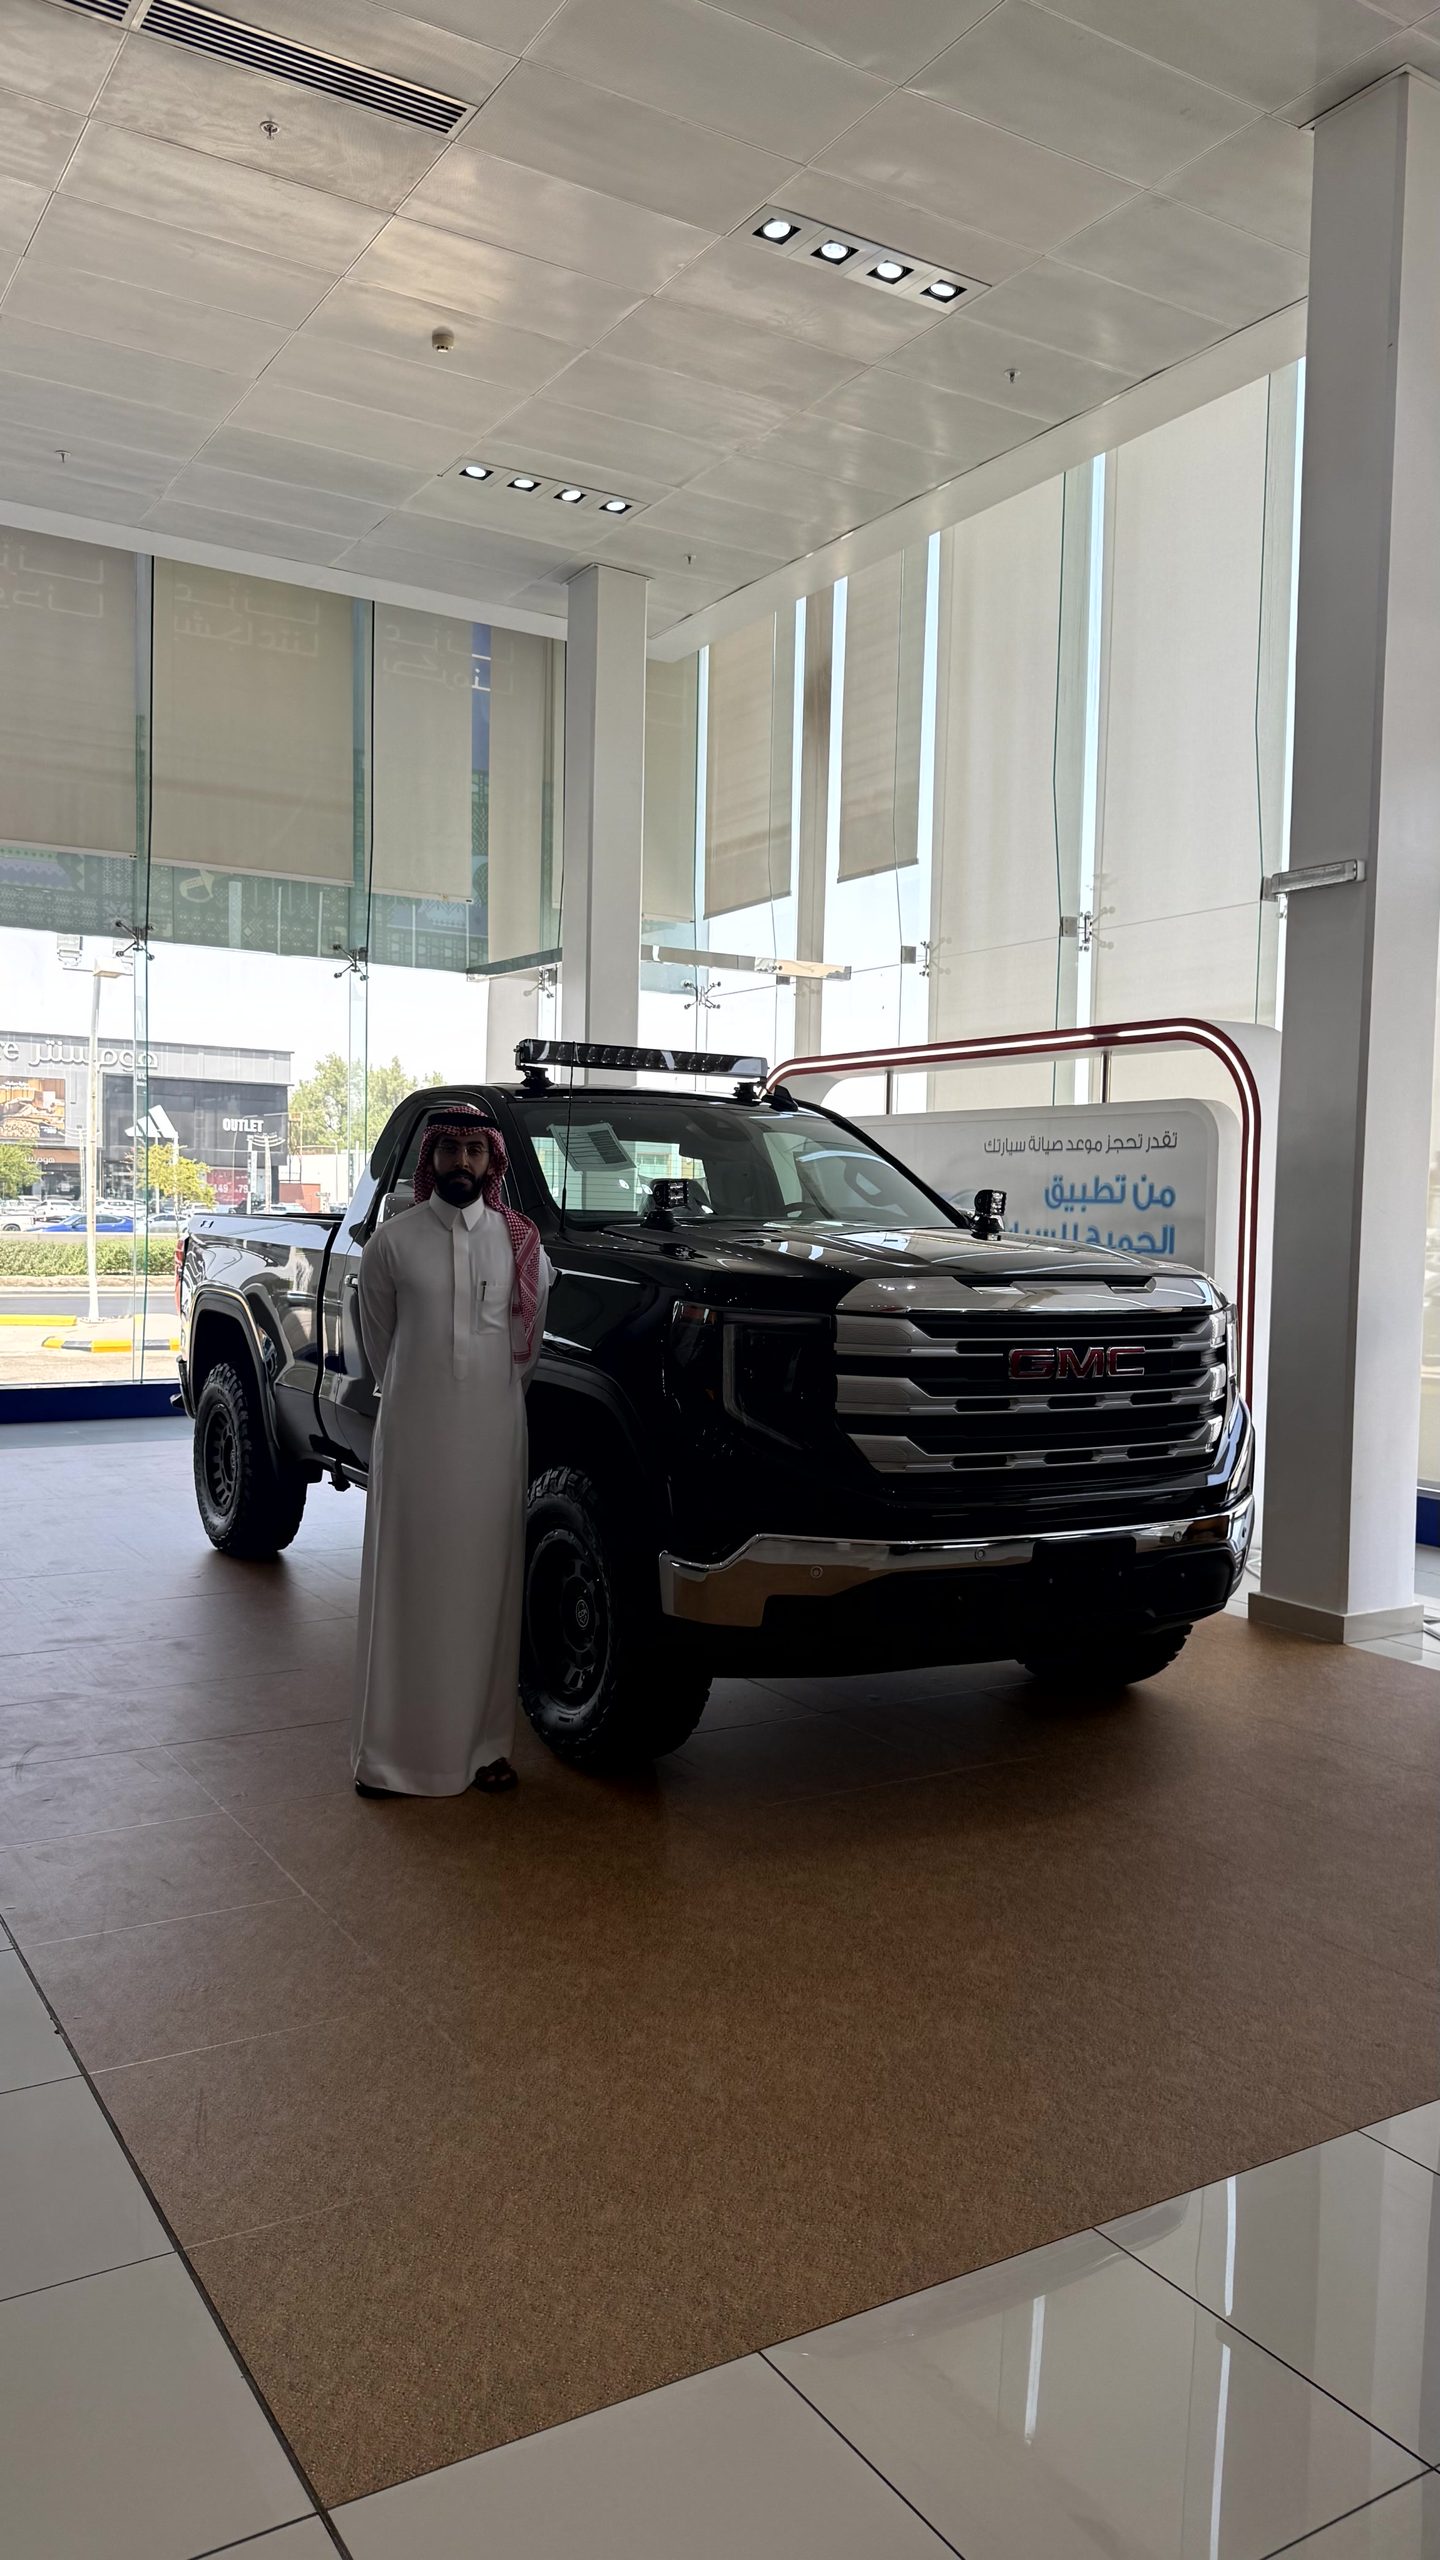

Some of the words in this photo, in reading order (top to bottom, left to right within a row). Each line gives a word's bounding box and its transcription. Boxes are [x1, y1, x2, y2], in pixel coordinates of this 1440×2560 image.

[222, 1117, 265, 1133] OUTLET
[984, 1136, 1026, 1156] سيارتك
[1028, 1135, 1063, 1155] صيانة
[1065, 1137, 1103, 1155] موعد
[1105, 1133, 1143, 1155] تحجز
[1145, 1131, 1178, 1153] تقدر
[1044, 1173, 1127, 1212] تطبيق
[1132, 1174, 1176, 1211] من
[1008, 1346, 1146, 1380] GMC
